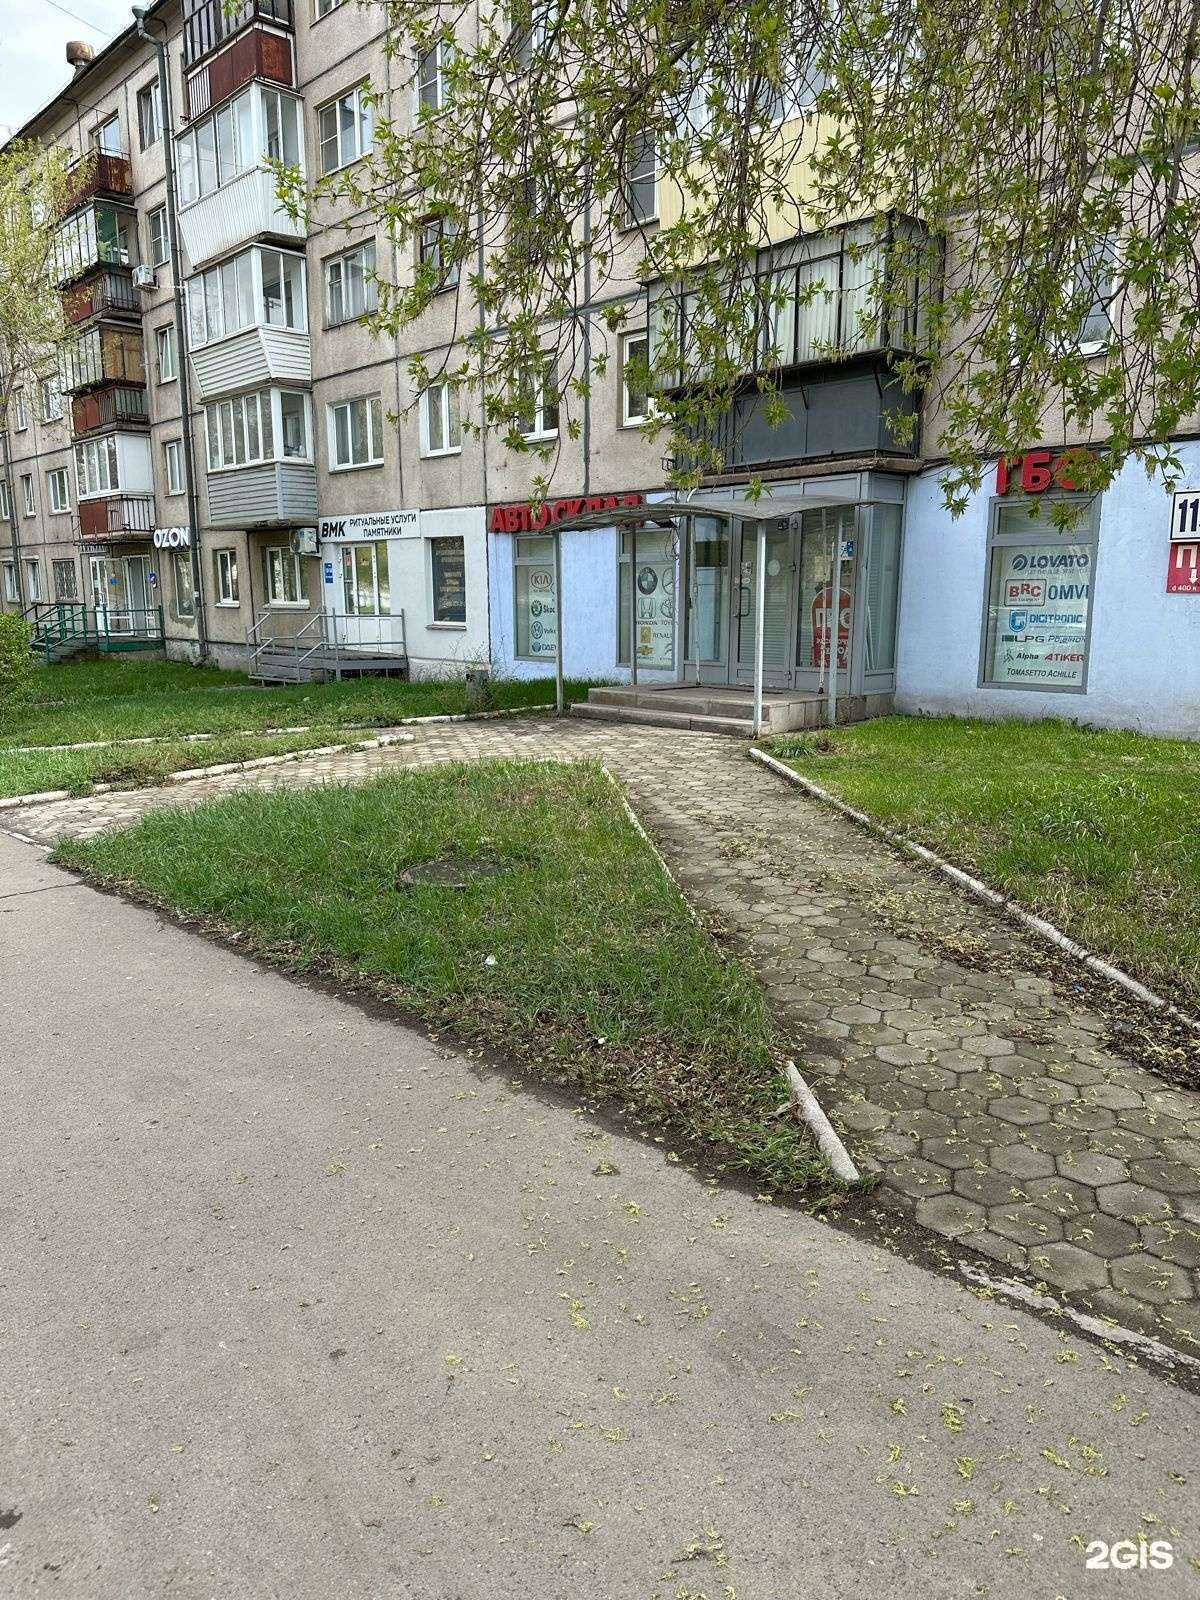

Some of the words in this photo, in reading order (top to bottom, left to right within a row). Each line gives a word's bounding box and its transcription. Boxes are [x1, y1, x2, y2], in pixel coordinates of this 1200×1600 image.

[349, 515, 389, 527] РИТУАЛЬНЫЕ
[390, 513, 416, 524] УСЛУГИ
[1178, 498, 1200, 533] 11
[321, 520, 346, 538] ВМК
[363, 526, 402, 537] ПАМЯТНИКИ
[153, 526, 190, 548] OZON
[1029, 553, 1089, 569] LOVATO
[1175, 544, 1198, 569] П
[534, 575, 550, 585] KIA
[1009, 583, 1042, 598] BRC
[1016, 652, 1040, 661] Alpha
[1044, 653, 1086, 662] ATIKER
[1007, 667, 1047, 677] TOMASETTO
[1047, 669, 1078, 679] ACHILLE
